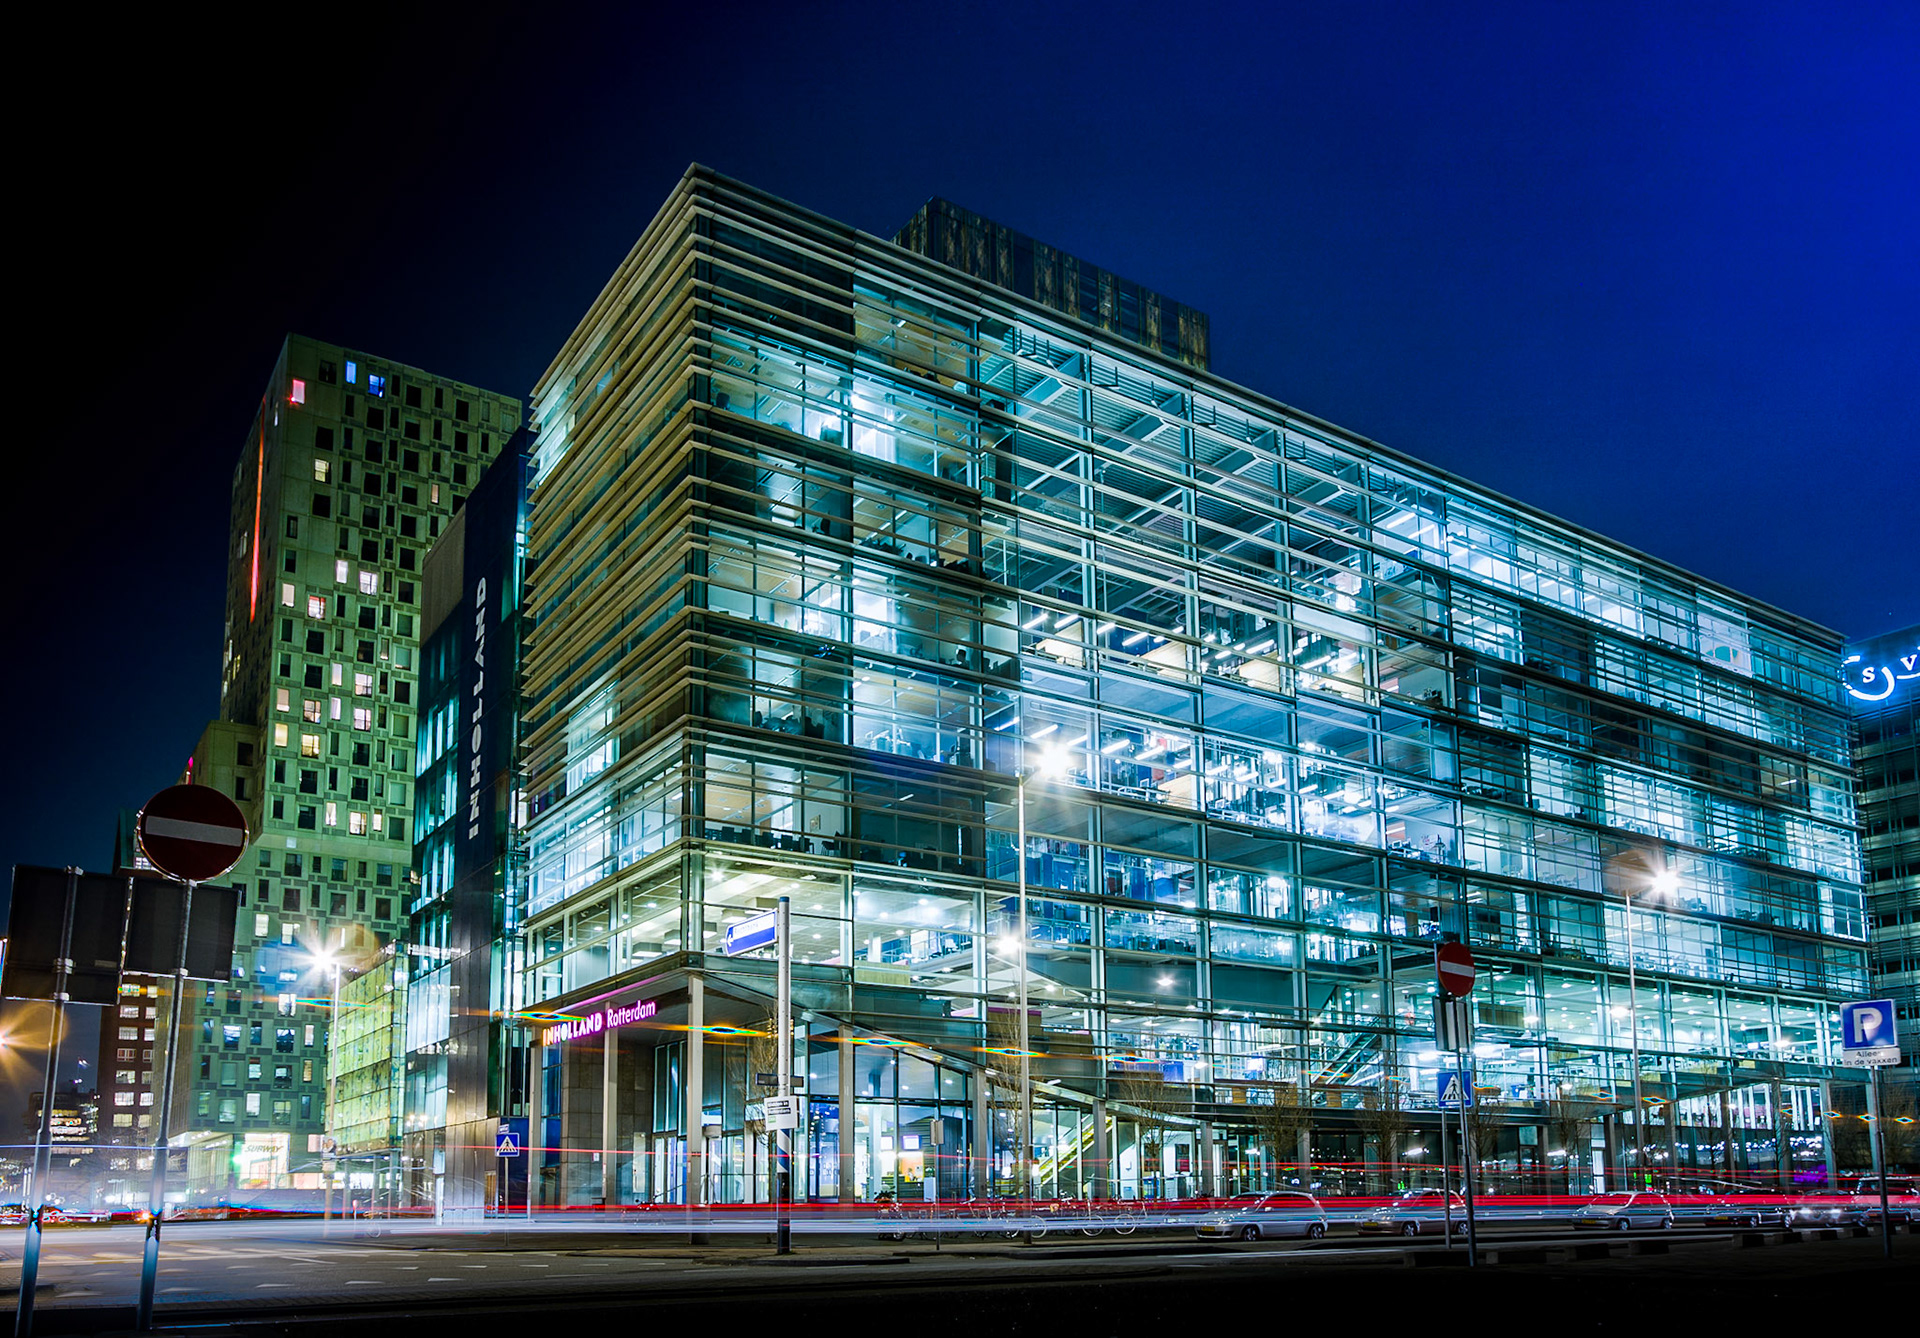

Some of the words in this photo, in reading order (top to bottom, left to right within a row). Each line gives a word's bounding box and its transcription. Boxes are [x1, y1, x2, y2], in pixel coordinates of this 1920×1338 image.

[469, 577, 486, 840] INHOLLAND
[543, 1012, 602, 1047] INHOLLAND
[607, 1000, 656, 1028] Rotterdam
[1852, 1007, 1883, 1043] P
[1854, 1058, 1865, 1066] de
[244, 1145, 284, 1153] SUBWAY
